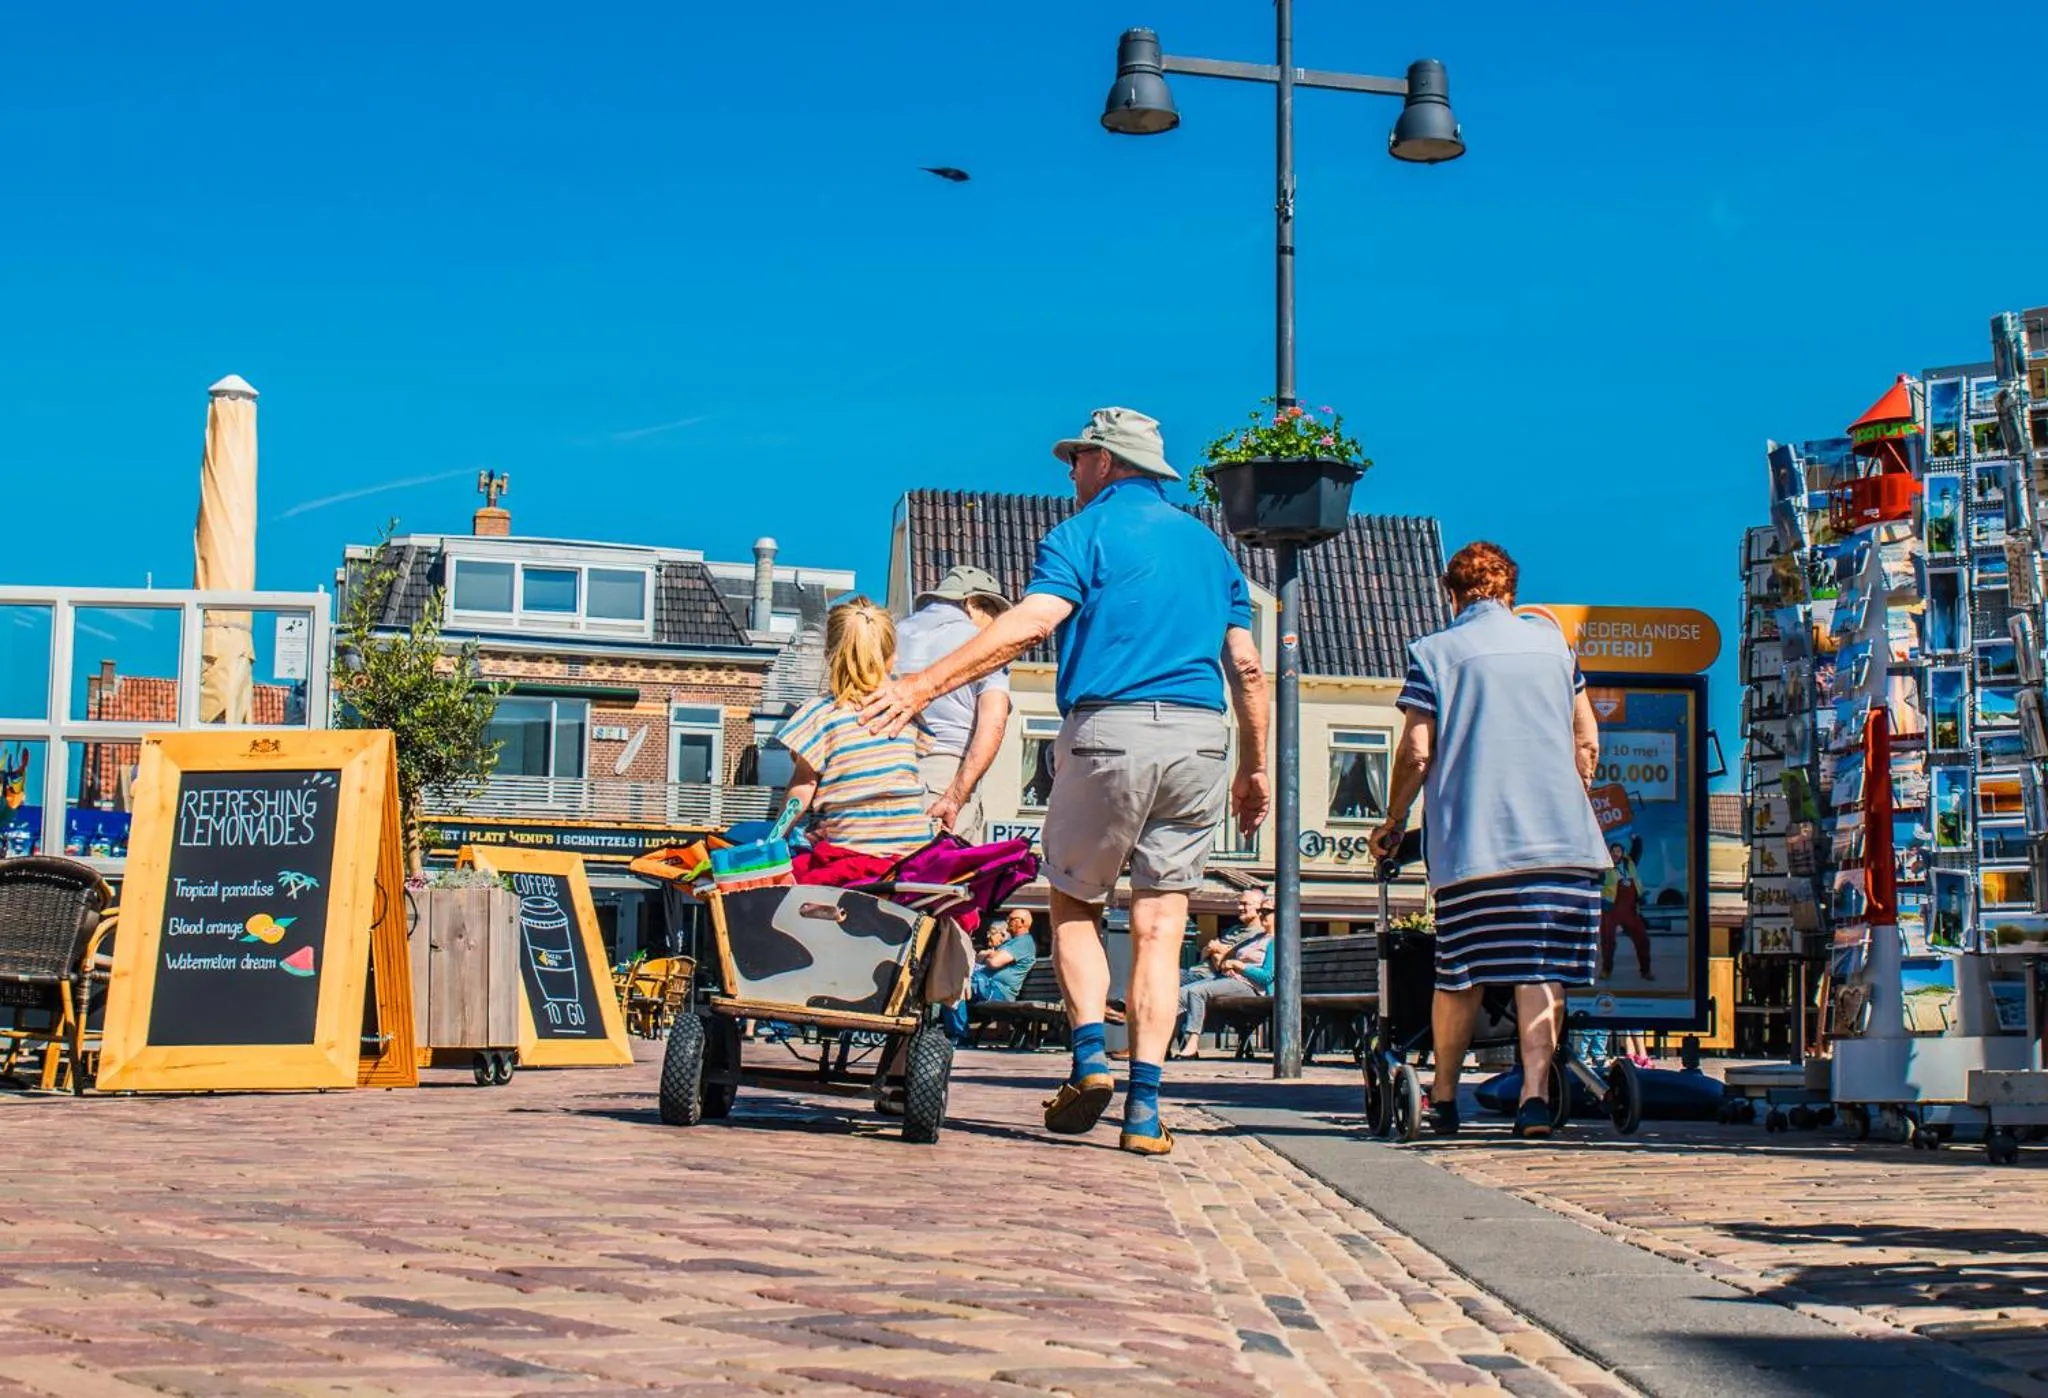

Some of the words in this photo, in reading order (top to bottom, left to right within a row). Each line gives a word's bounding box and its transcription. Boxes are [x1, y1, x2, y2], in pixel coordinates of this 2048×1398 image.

[1575, 622, 1700, 640] NEDERLANDSE
[1574, 640, 1653, 657] LOTERIJ
[1612, 744, 1628, 756] 10
[1633, 746, 1658, 757] mei
[180, 789, 317, 818] REFRESHING
[179, 814, 315, 846] LEMONADES
[469, 831, 505, 843] PLATE
[563, 834, 637, 849] SCHNITZELS
[174, 878, 218, 902] Tropical
[222, 880, 274, 902] paradise
[168, 917, 204, 935] Blood
[206, 921, 244, 940] orange
[166, 953, 236, 970] Watermelon
[240, 953, 277, 970] dream
[543, 1001, 562, 1025] TO
[567, 1003, 585, 1026] GO
